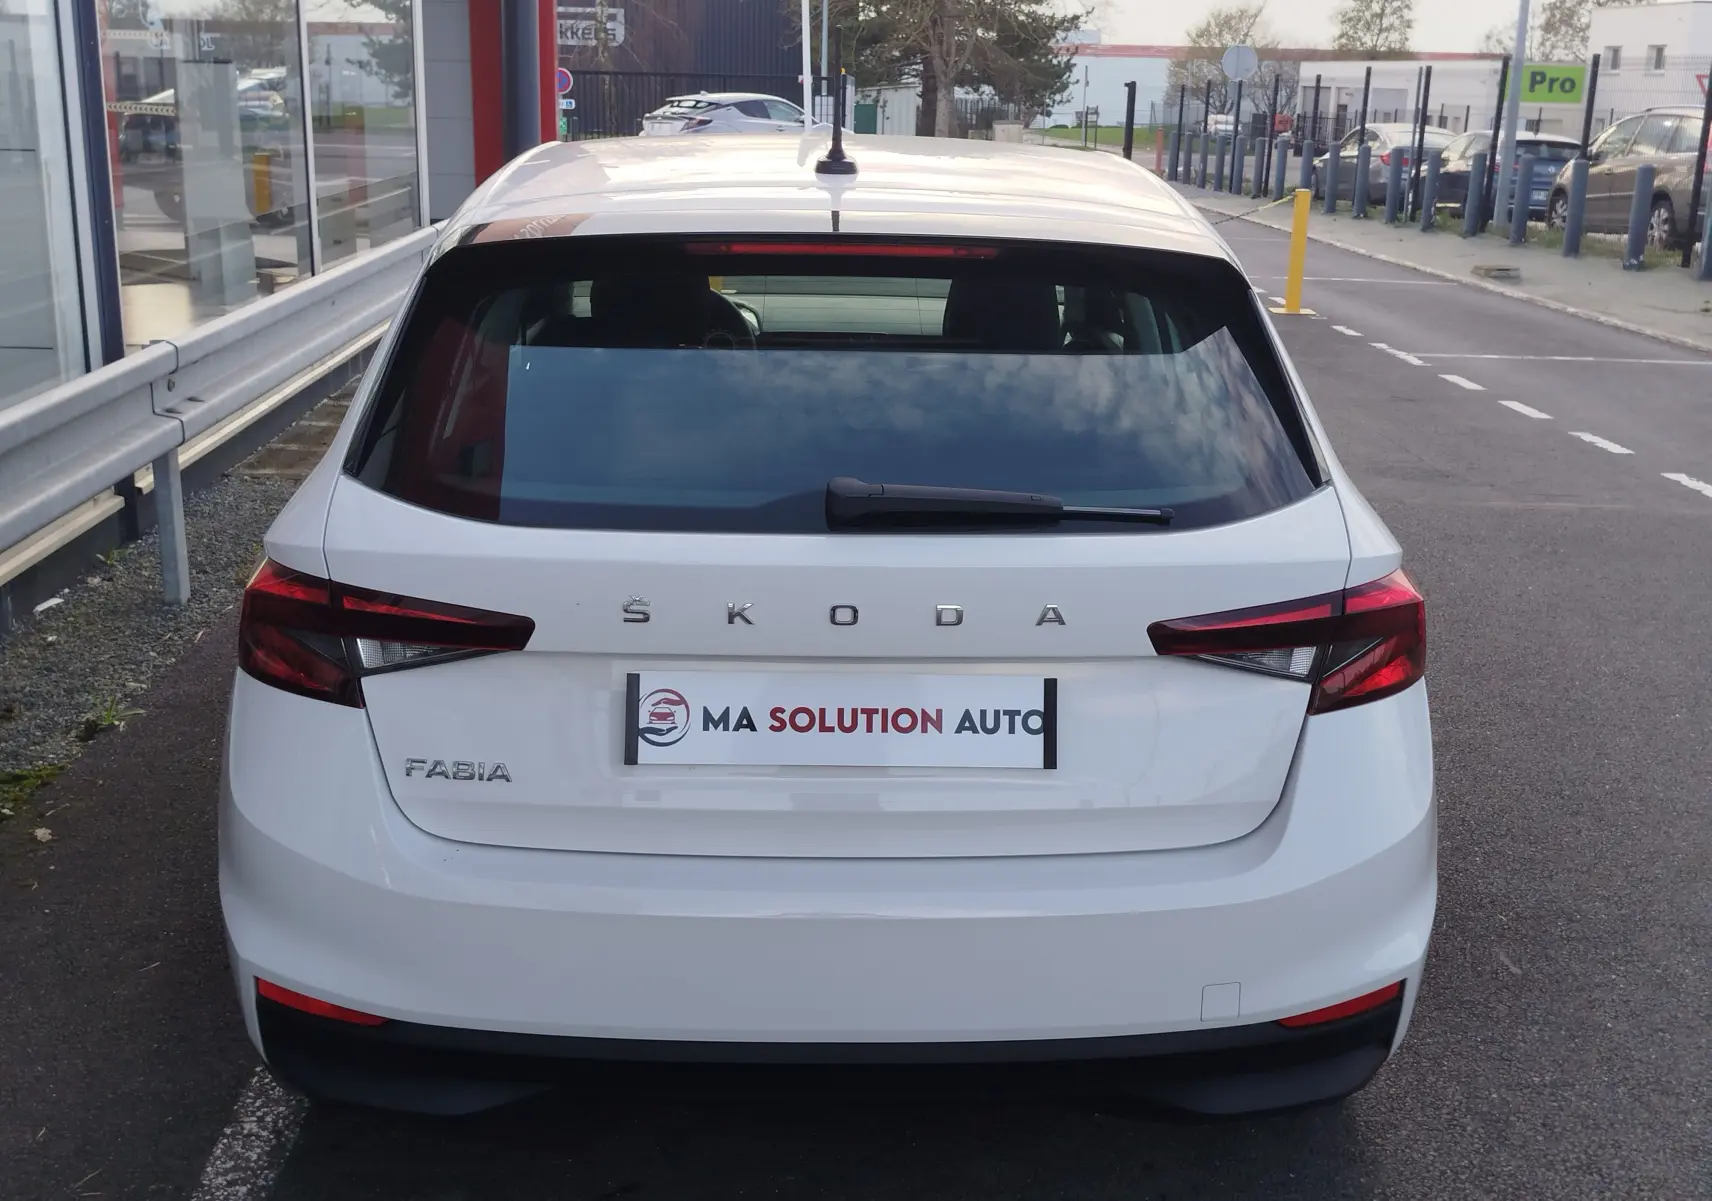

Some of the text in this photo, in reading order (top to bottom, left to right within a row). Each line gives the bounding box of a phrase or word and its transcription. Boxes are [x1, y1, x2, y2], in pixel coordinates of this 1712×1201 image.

[1528, 71, 1576, 93] Pro
[622, 595, 1066, 626] ŠKODA
[702, 706, 1045, 736] MA SOLUTION AUTO
[405, 757, 512, 782] FABIA
